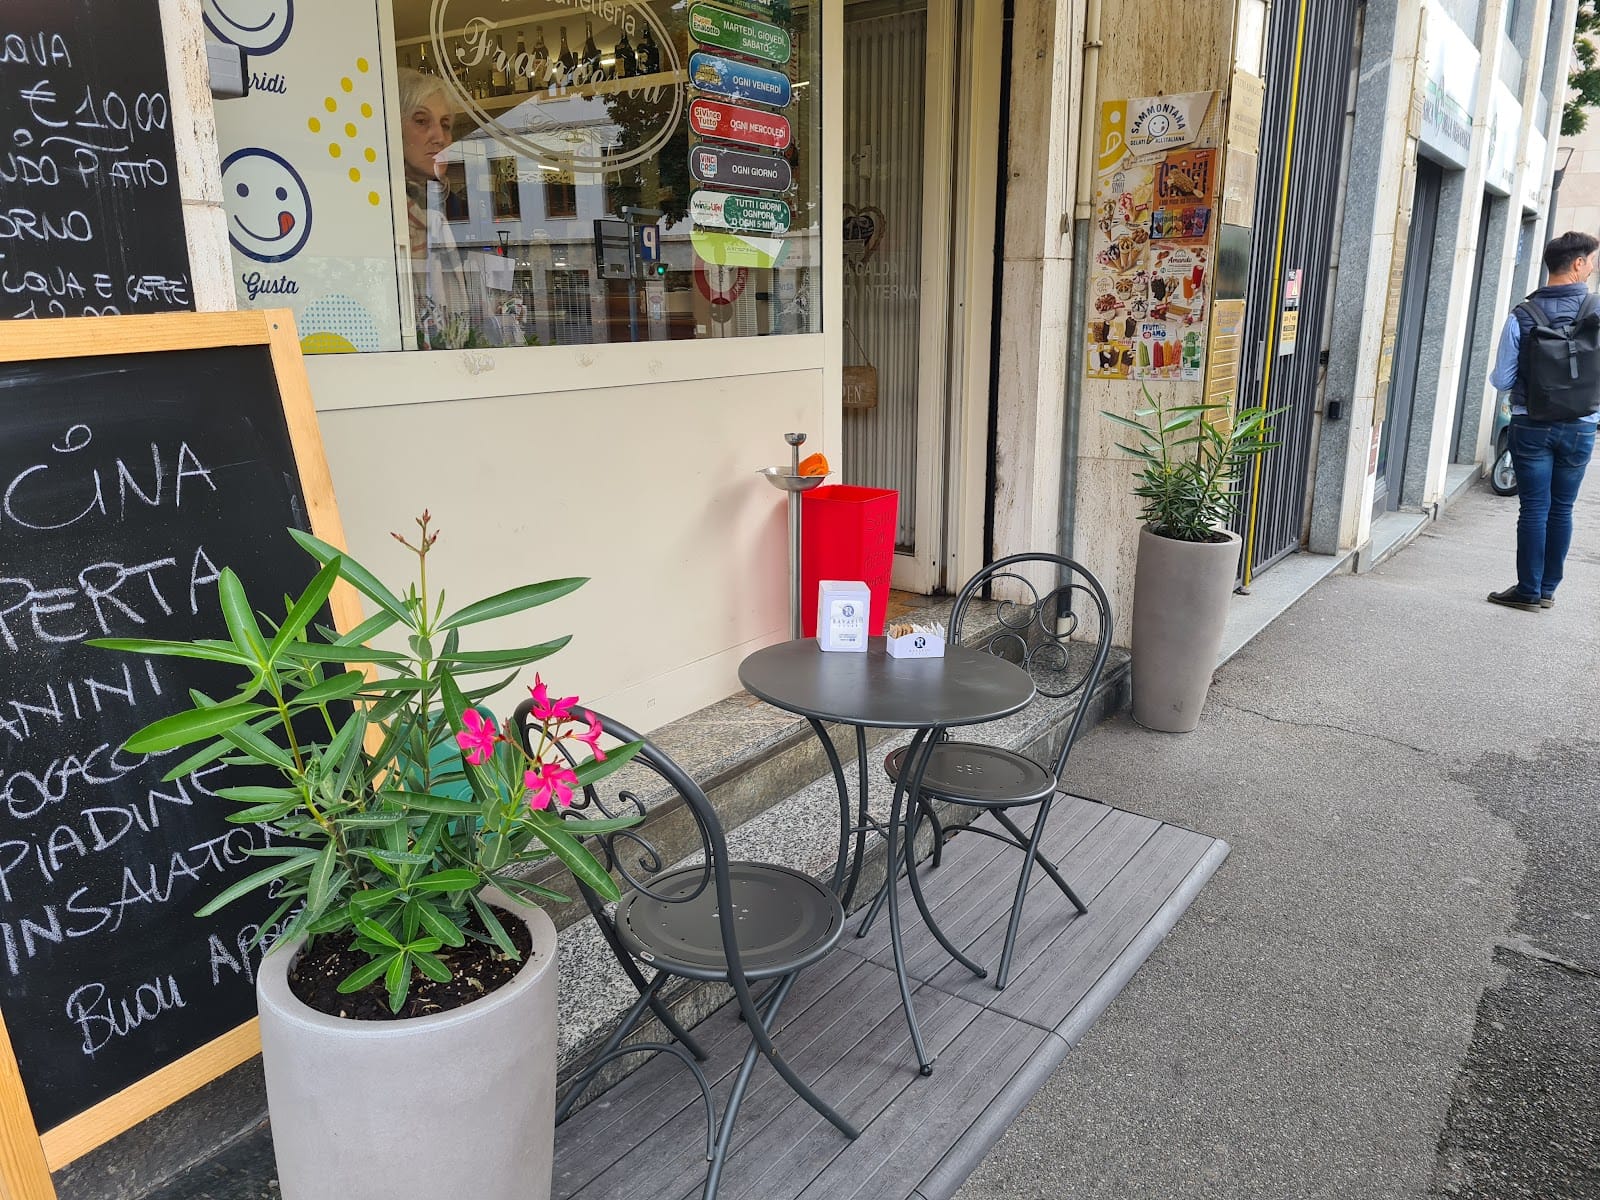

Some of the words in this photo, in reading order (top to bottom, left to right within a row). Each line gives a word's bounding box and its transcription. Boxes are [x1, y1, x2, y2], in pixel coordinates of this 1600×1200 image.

[248, 72, 287, 94] ridi
[732, 75, 751, 88] OGNI
[1131, 103, 1186, 134] SAMMONTANA
[730, 119, 748, 133] OGNI
[732, 165, 750, 175] OGNI
[751, 166, 778, 179] GIORNO
[736, 199, 754, 209] TUTTI
[759, 201, 782, 212] GIORNI
[242, 272, 299, 300] Gusta
